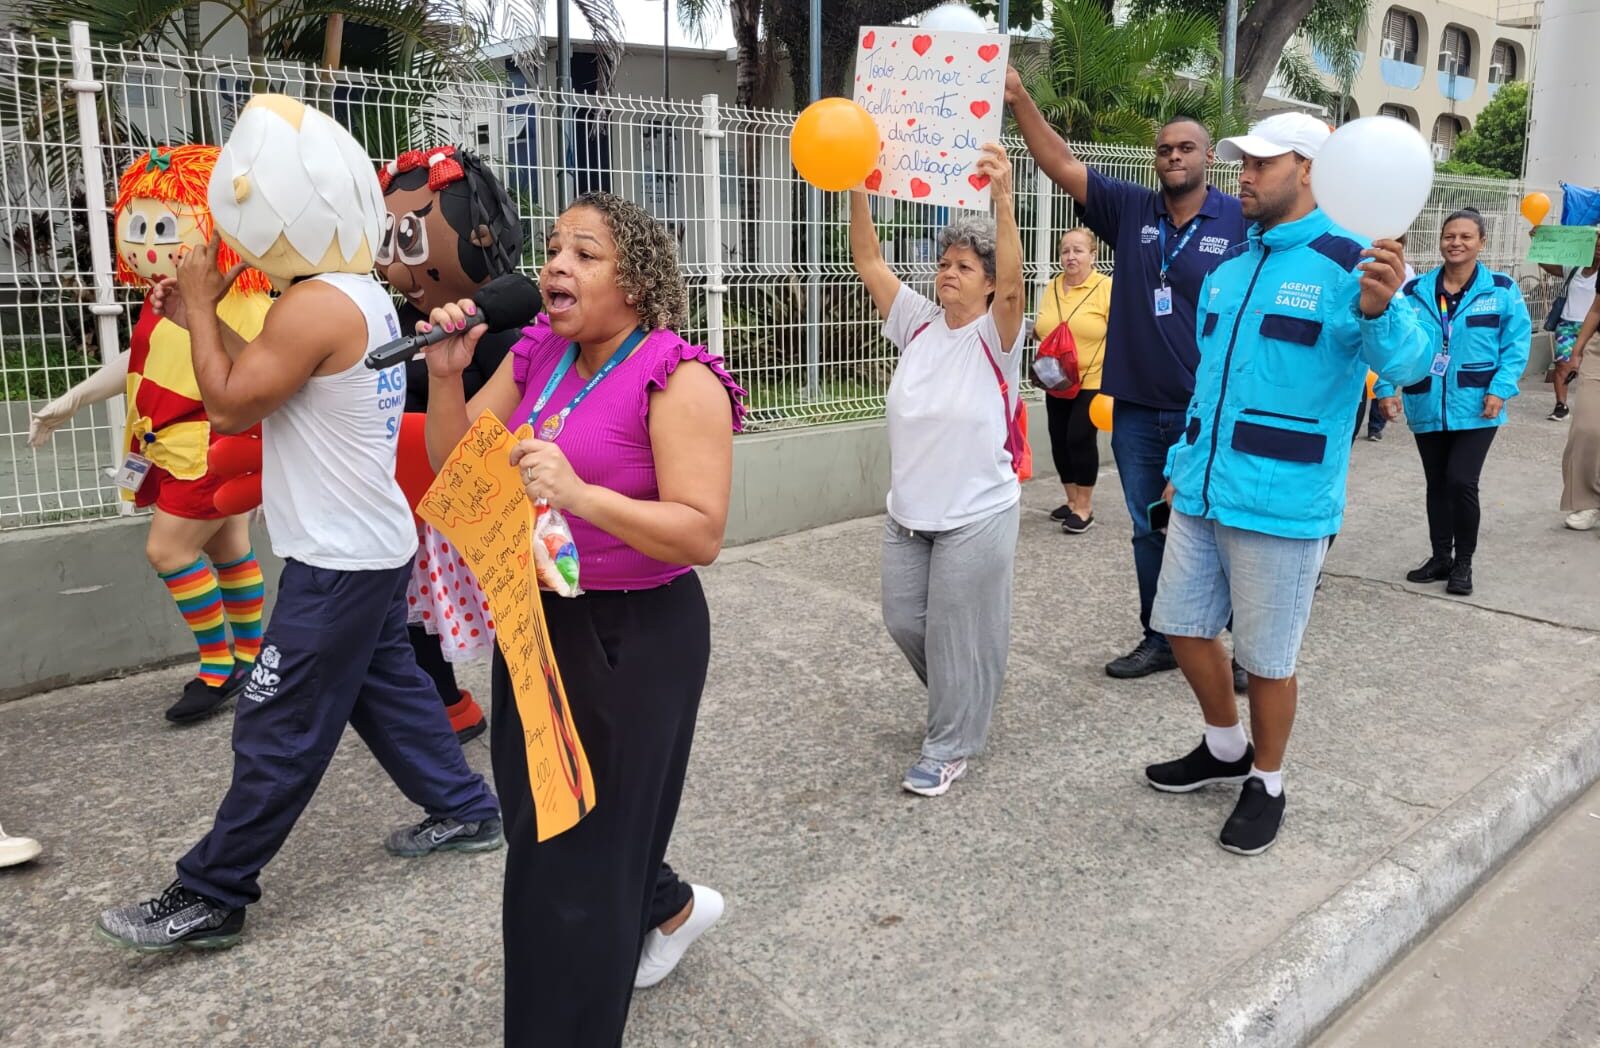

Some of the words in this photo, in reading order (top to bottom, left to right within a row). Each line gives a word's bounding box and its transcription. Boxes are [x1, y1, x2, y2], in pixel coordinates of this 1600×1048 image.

[865, 47, 895, 79] Todo
[902, 65, 964, 87] amor
[976, 69, 996, 84] é
[888, 122, 944, 146] dentro
[952, 129, 982, 151] de
[892, 150, 972, 185] abraço
[1200, 235, 1229, 246] AGENTE
[1280, 281, 1322, 295] AGENTE
[1274, 295, 1318, 312] SAÚDE
[448, 471, 464, 494] não
